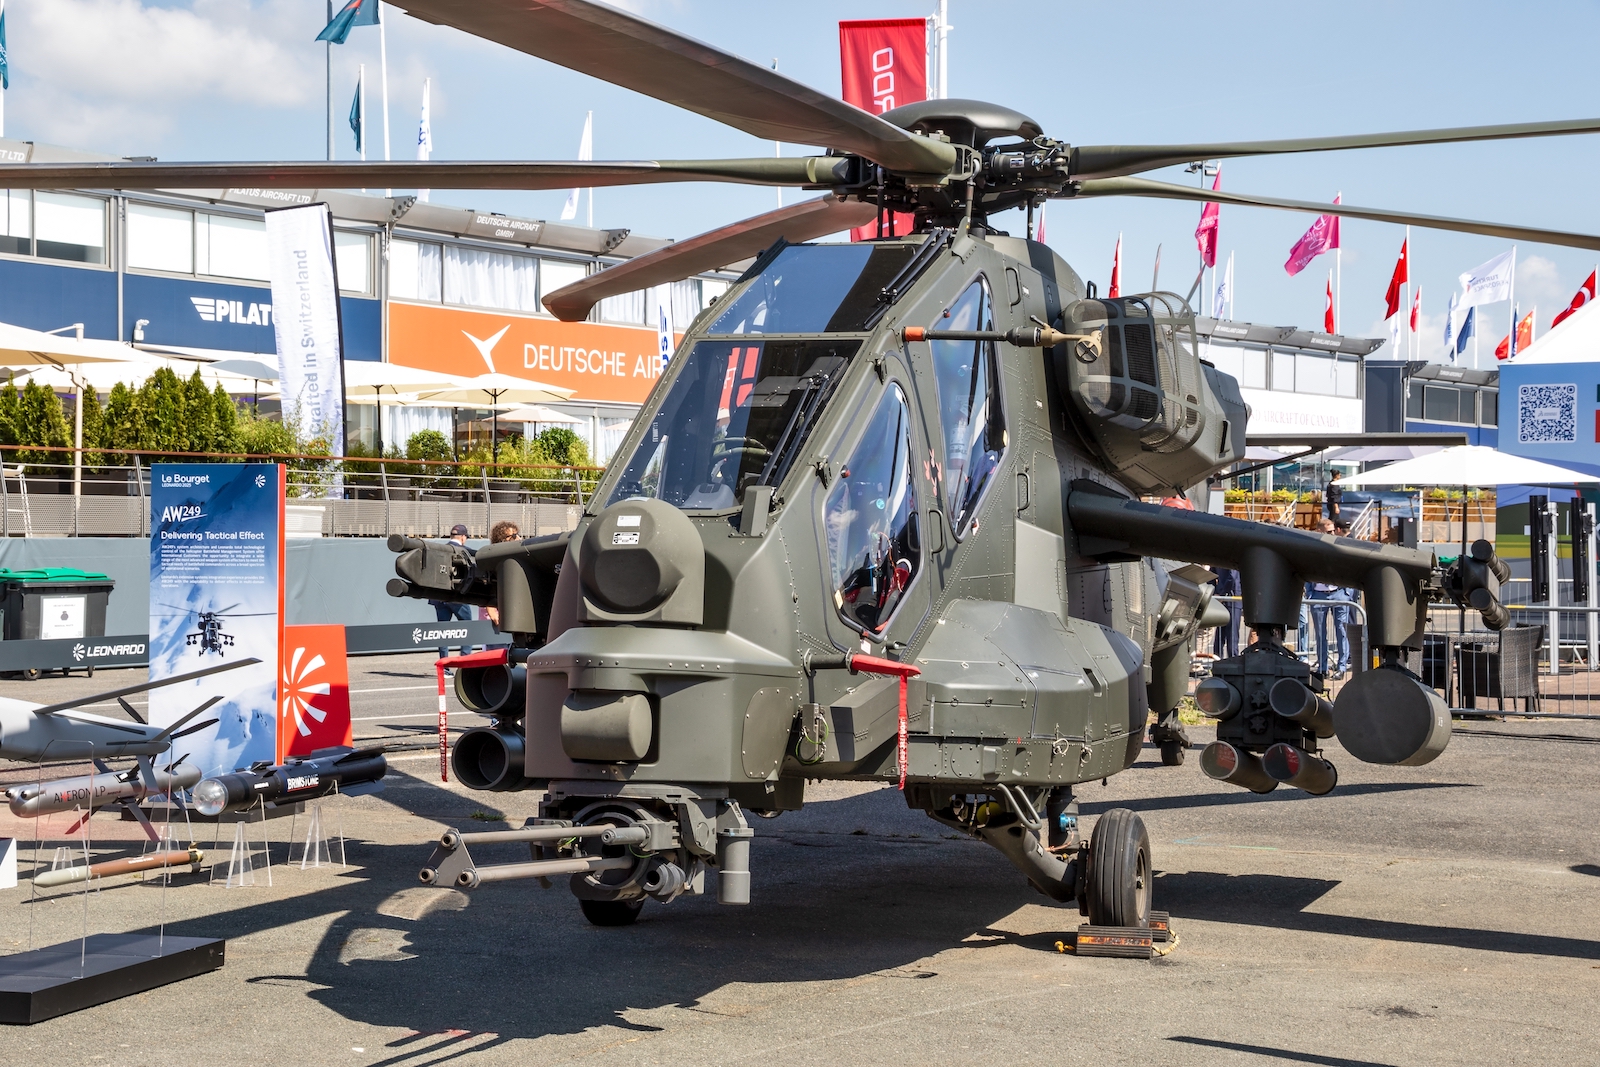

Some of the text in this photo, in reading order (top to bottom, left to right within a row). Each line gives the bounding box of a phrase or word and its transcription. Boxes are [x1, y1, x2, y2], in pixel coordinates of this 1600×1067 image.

[8, 151, 25, 161] LTD
[260, 190, 297, 202] AIRCRAFT
[297, 195, 311, 203] LTD
[476, 216, 540, 232] DEUTSCHE AIRCRAFT
[495, 229, 515, 238] GMBH
[216, 299, 275, 326] PILAT
[524, 343, 626, 376] DEUTSCHE
[1264, 410, 1298, 424] AIRCRAFT
[1310, 414, 1340, 428] CANADA
[162, 474, 210, 485] Le Bourget
[162, 506, 201, 522] AW249
[161, 532, 264, 541] Delivering Tactical Effect
[422, 629, 468, 640] LEONARDO
[86, 644, 145, 657] LEONARDO
[95, 786, 106, 797] LP
